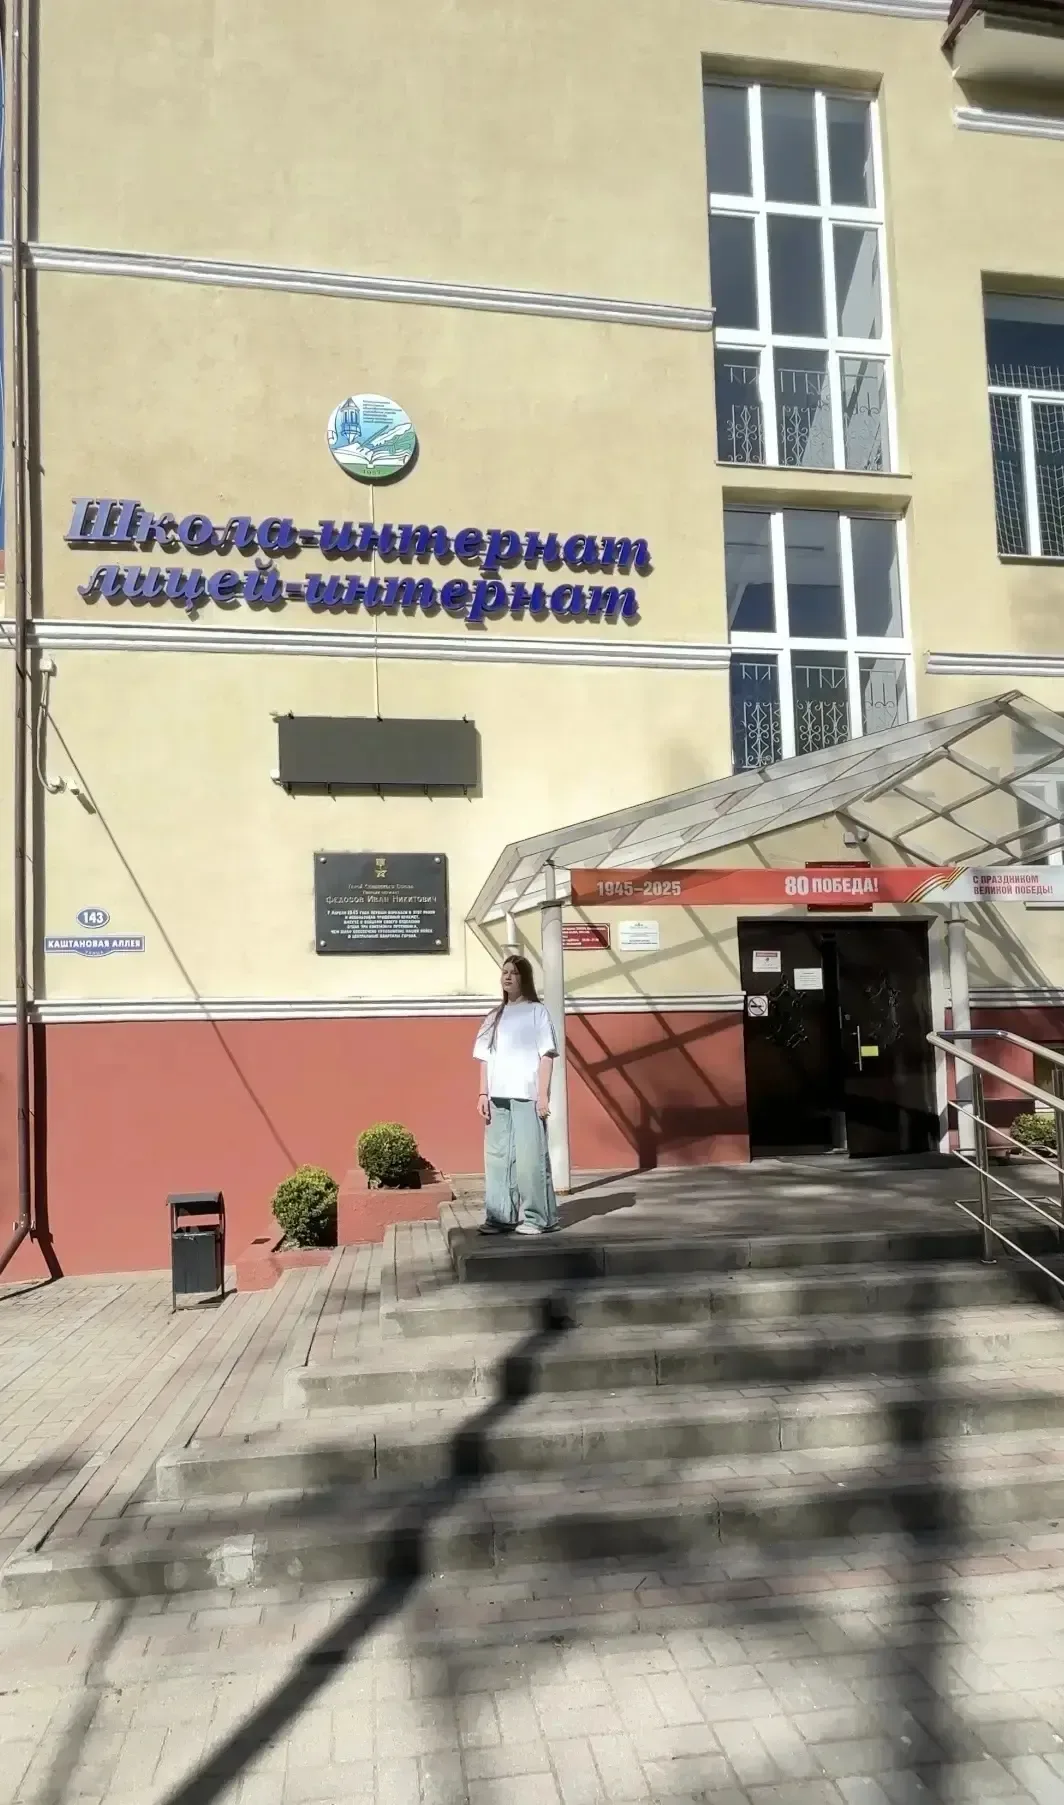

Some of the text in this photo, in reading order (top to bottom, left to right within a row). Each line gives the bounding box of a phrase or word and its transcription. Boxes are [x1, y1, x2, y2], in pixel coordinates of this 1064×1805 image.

[64, 497, 652, 573] Школа-интернат
[78, 558, 639, 623] лицей-интернат
[973, 874, 1039, 885] С ПРАЗДНИКОМ
[785, 876, 879, 896] 80 ПОБЕДА!
[974, 884, 1054, 895] ВЕЛИКОЙ ПОБЕДЫ!
[83, 911, 104, 923] 143
[48, 939, 141, 948] КАШТАНОВАЯ АЛЛЕЯ
